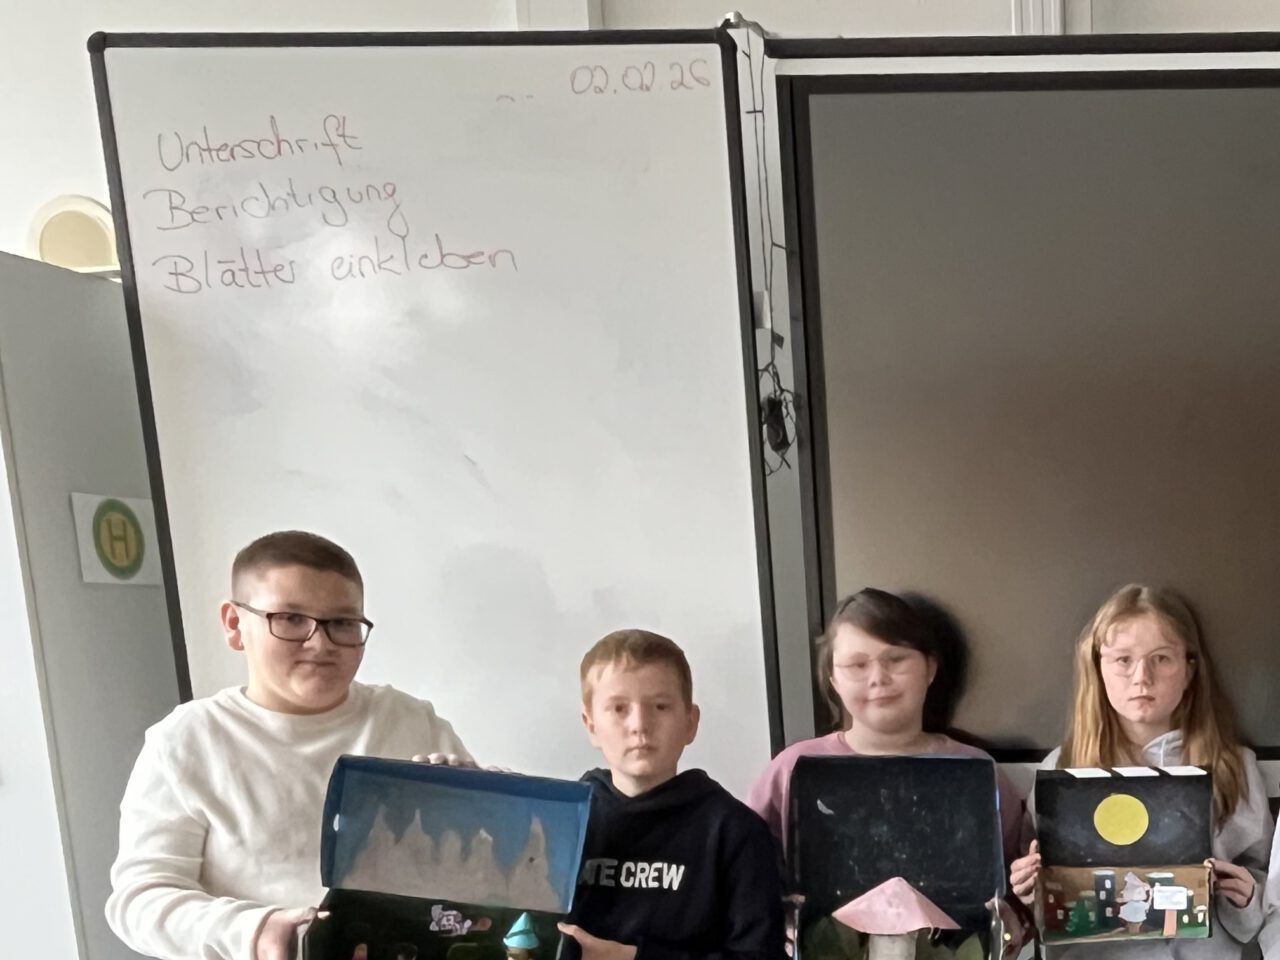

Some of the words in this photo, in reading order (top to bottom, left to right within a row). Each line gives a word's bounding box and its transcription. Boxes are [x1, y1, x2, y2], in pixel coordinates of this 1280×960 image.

[157, 114, 363, 170] Unterschrift
[142, 178, 409, 239] Berichtigung
[331, 233, 518, 281] einkleben
[580, 858, 618, 887] TE
[620, 861, 685, 890] CREW
